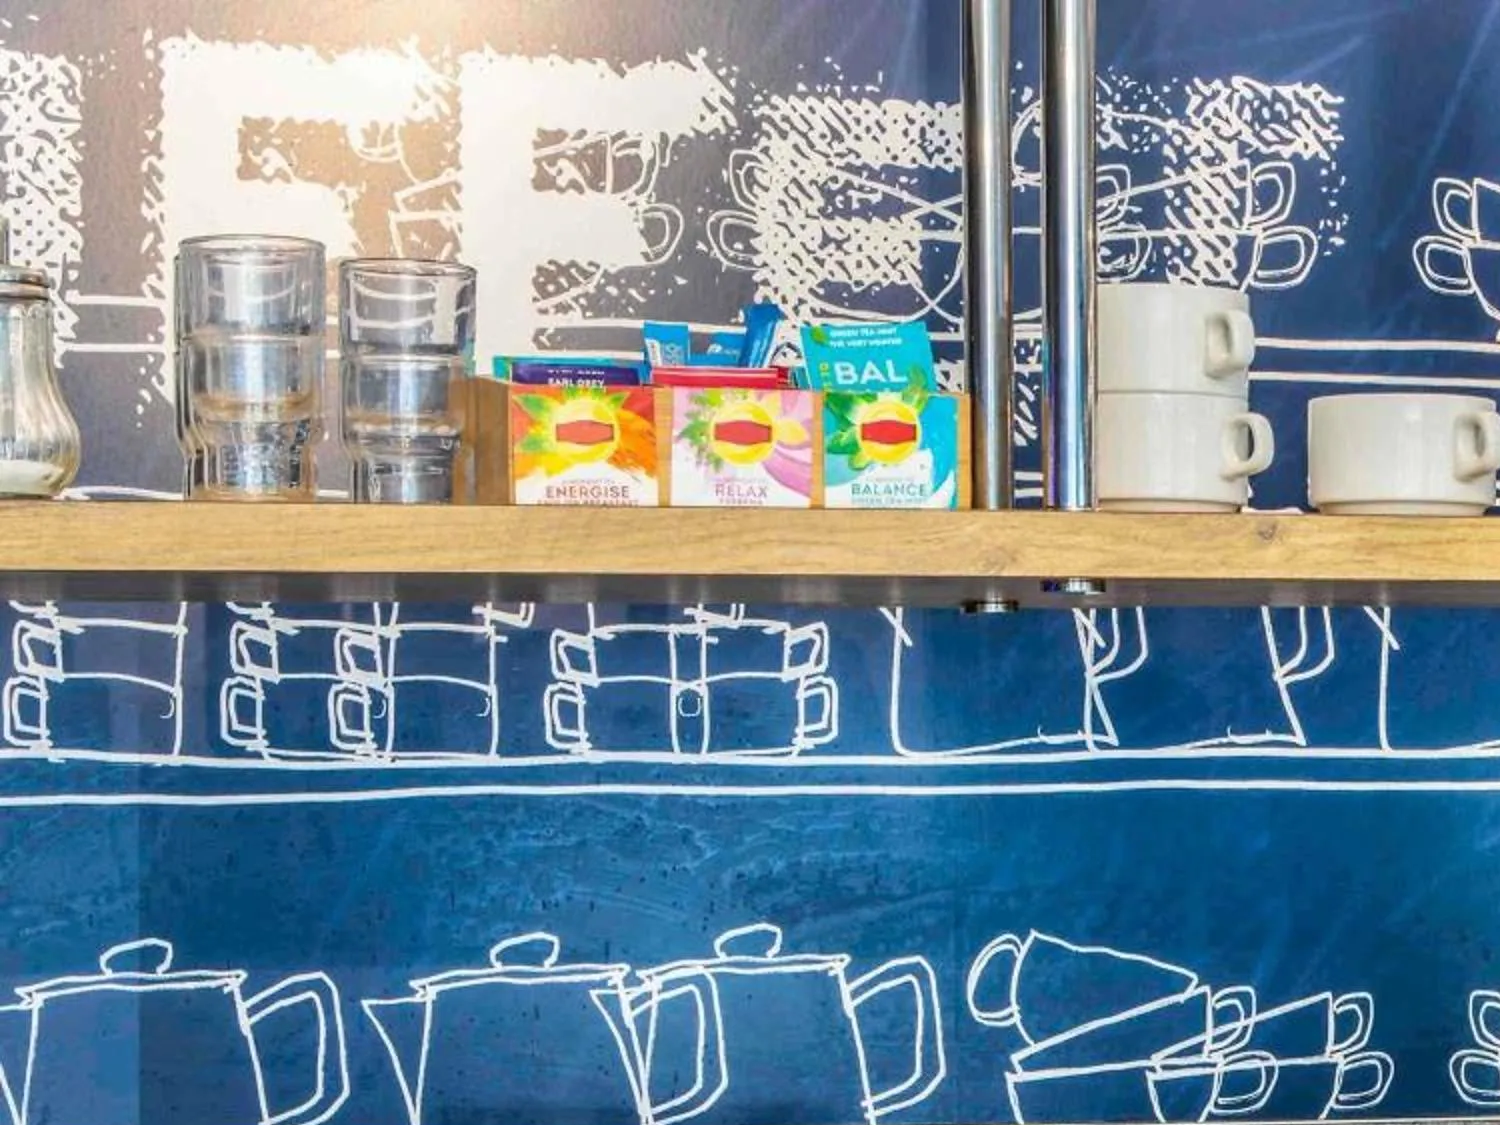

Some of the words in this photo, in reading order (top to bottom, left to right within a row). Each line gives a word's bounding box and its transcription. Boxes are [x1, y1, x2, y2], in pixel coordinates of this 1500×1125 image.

[834, 359, 908, 385] BAL
[545, 485, 630, 499] ENERGISE
[715, 483, 768, 498] RELAX
[851, 483, 926, 497] BALANCE
